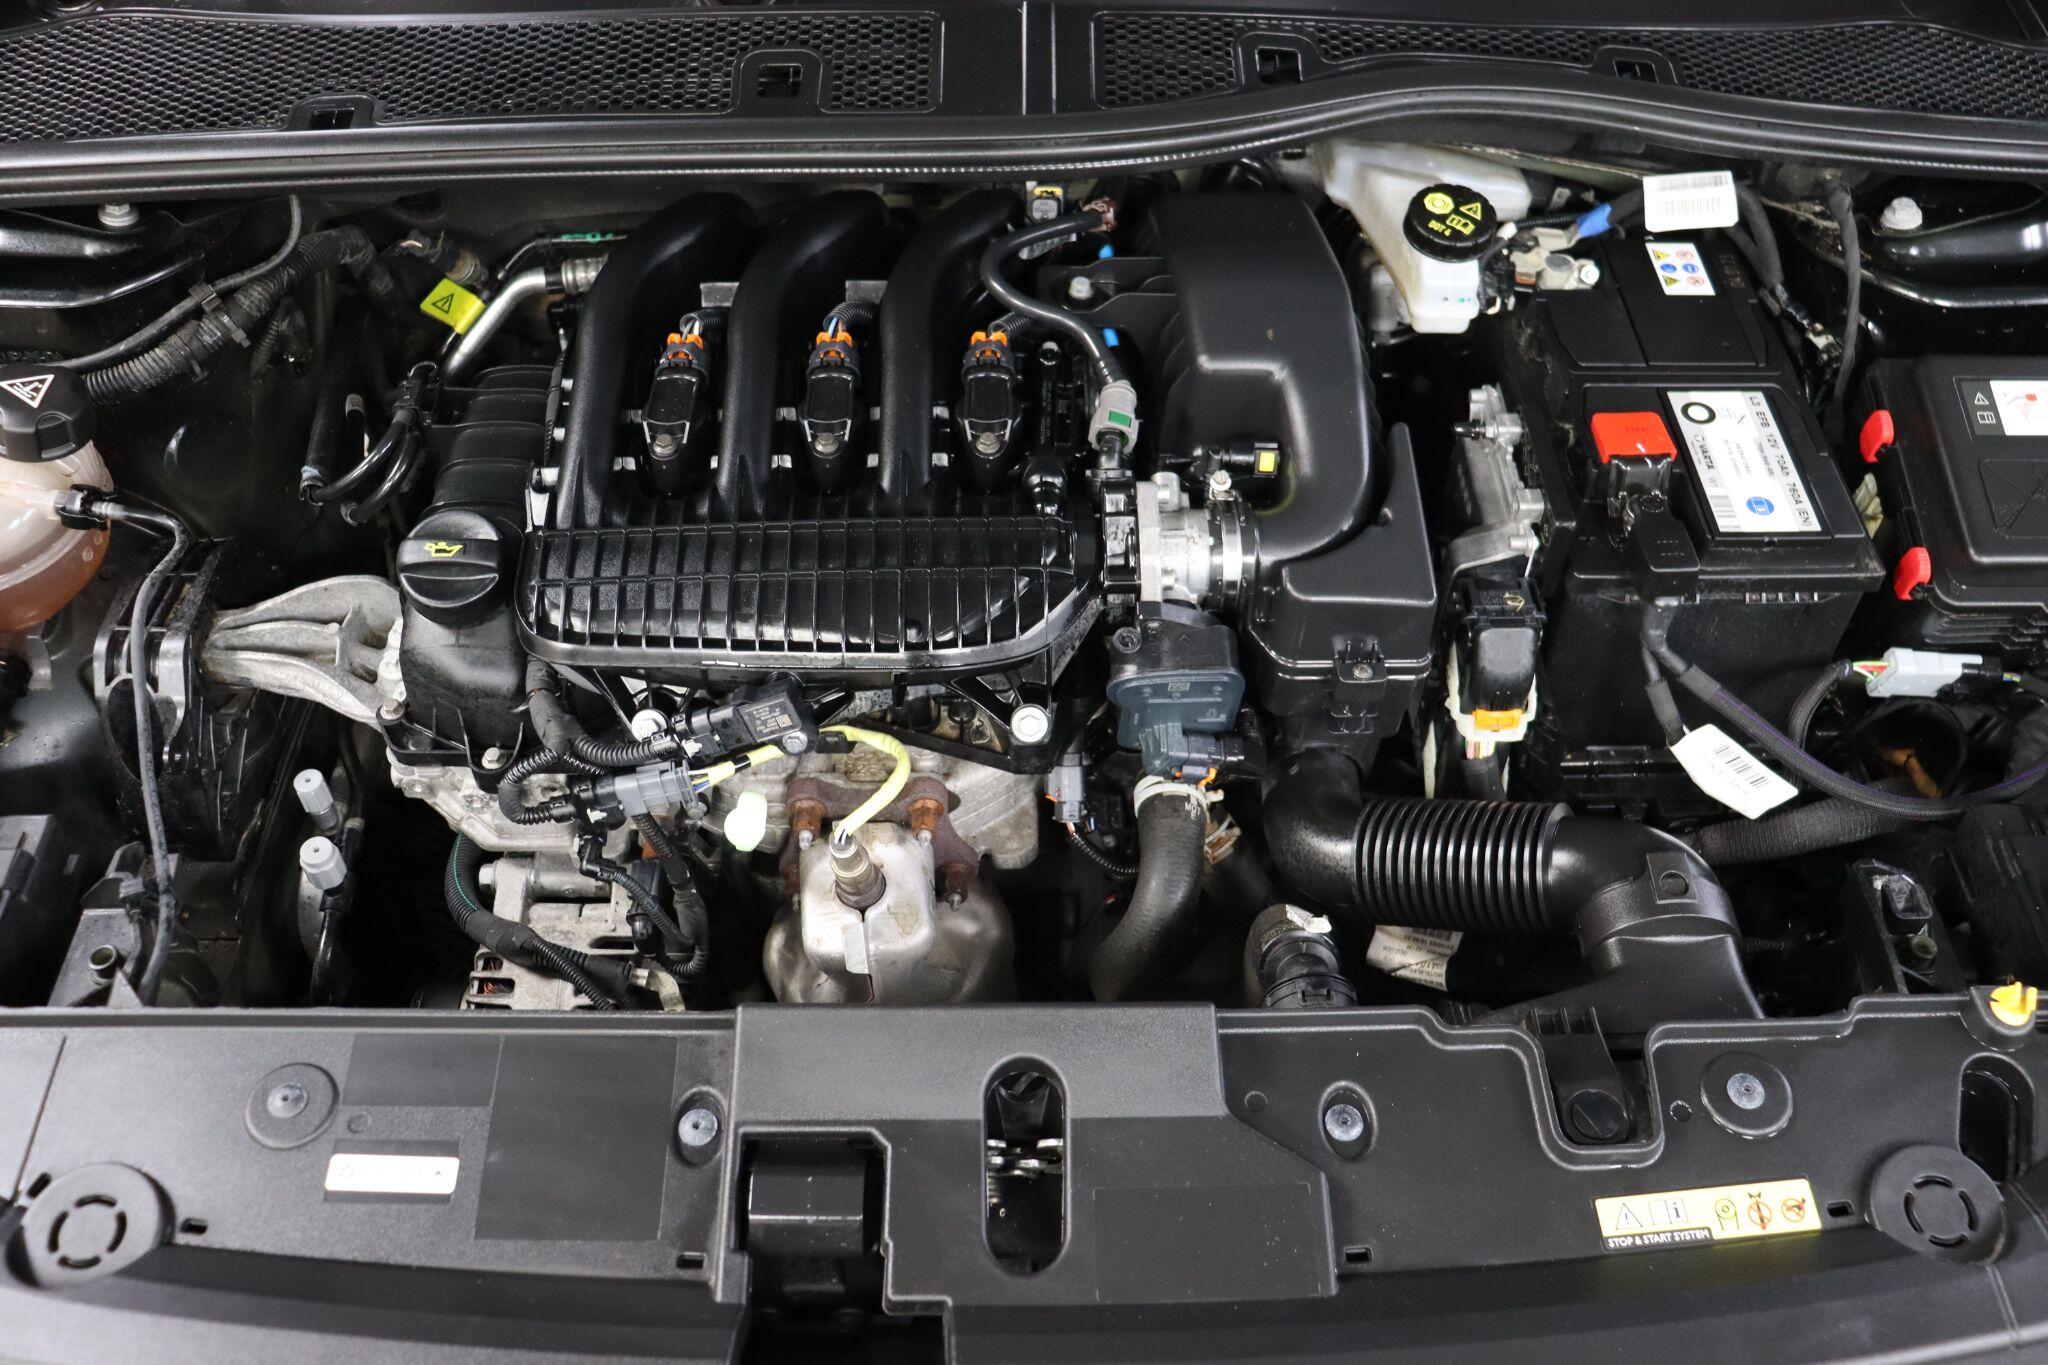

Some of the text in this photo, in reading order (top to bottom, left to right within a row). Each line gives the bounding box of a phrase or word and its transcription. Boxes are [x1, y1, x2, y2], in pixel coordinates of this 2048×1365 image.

[1700, 444, 1715, 471] VARTA
[1756, 411, 1770, 428] EFB
[1766, 433, 1780, 450] 12V
[1775, 454, 1790, 477] 70Ah
[1608, 1229, 1710, 1248] STOP & START SYSTEM
